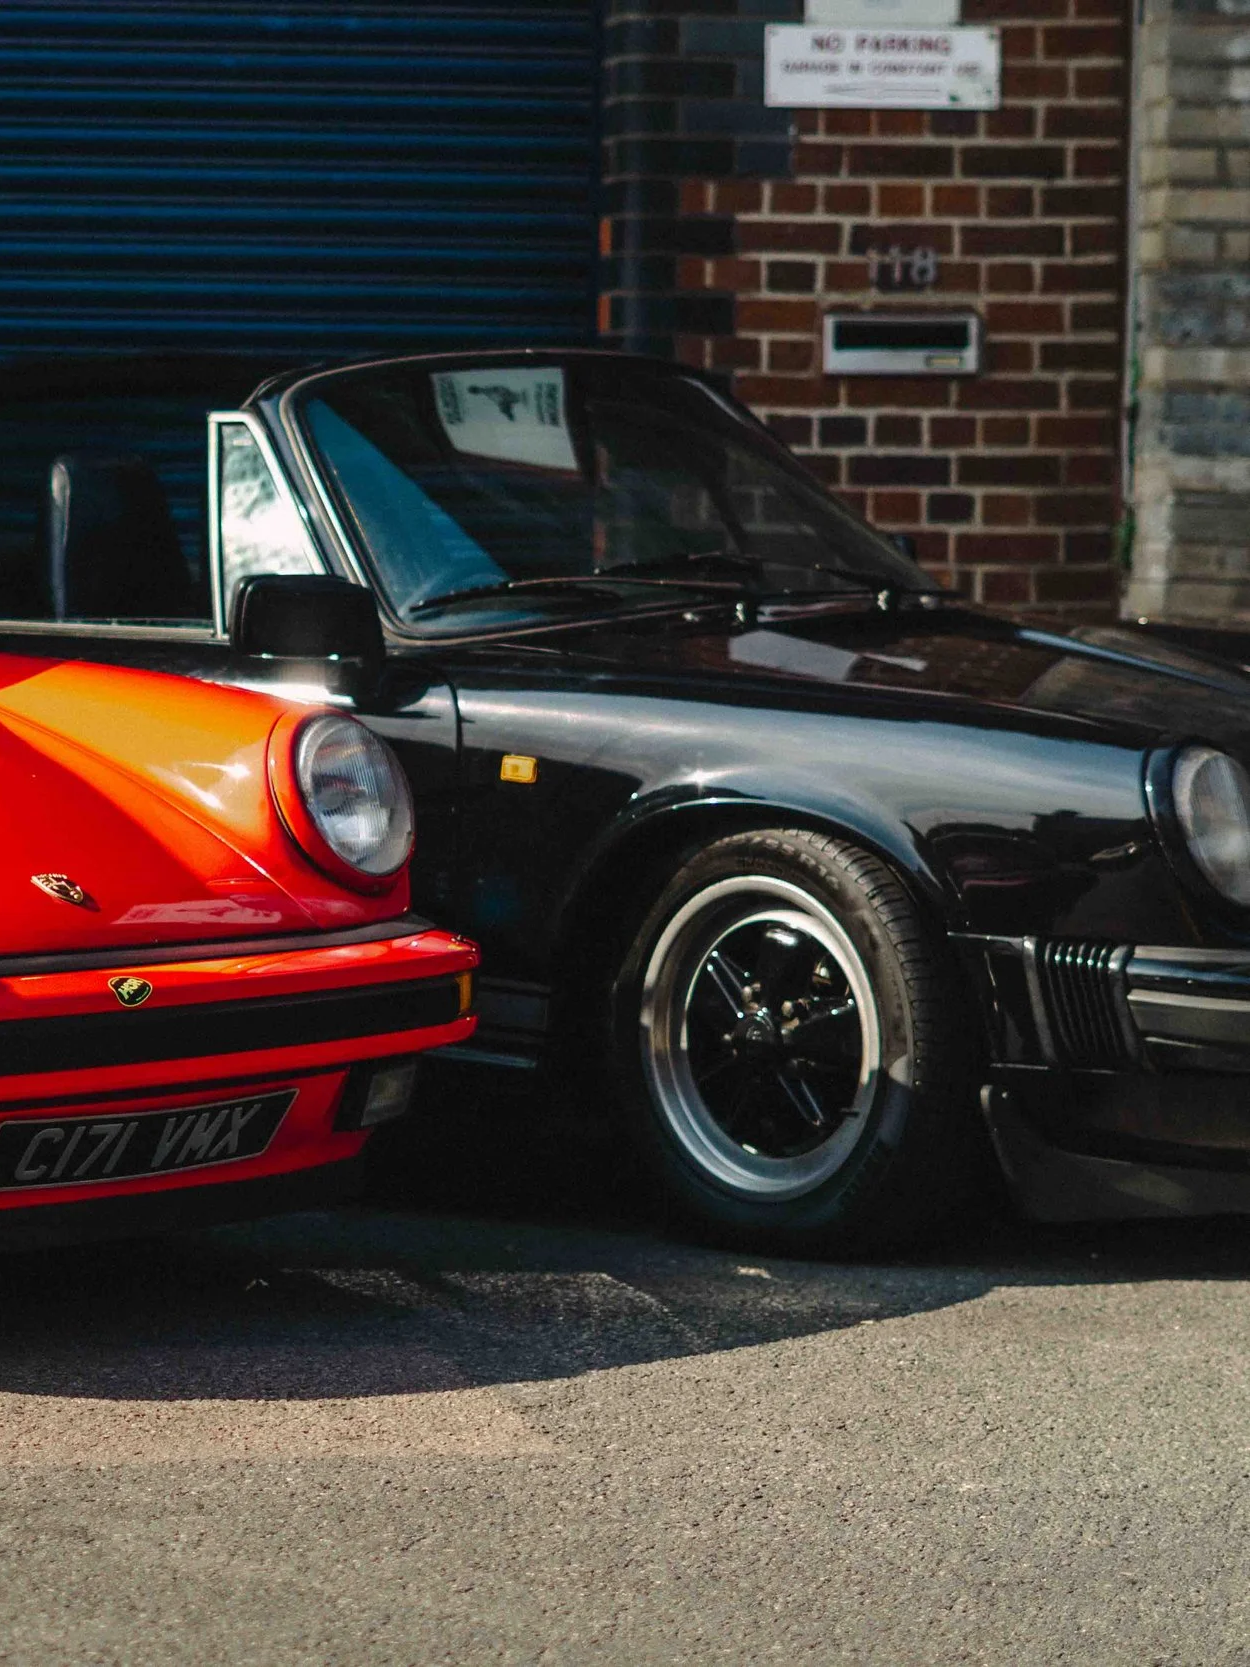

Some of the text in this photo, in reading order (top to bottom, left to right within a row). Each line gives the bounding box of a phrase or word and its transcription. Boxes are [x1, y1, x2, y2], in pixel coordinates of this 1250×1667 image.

[812, 33, 952, 55] NO PARKING
[13, 1103, 262, 1181] C171 VMX
